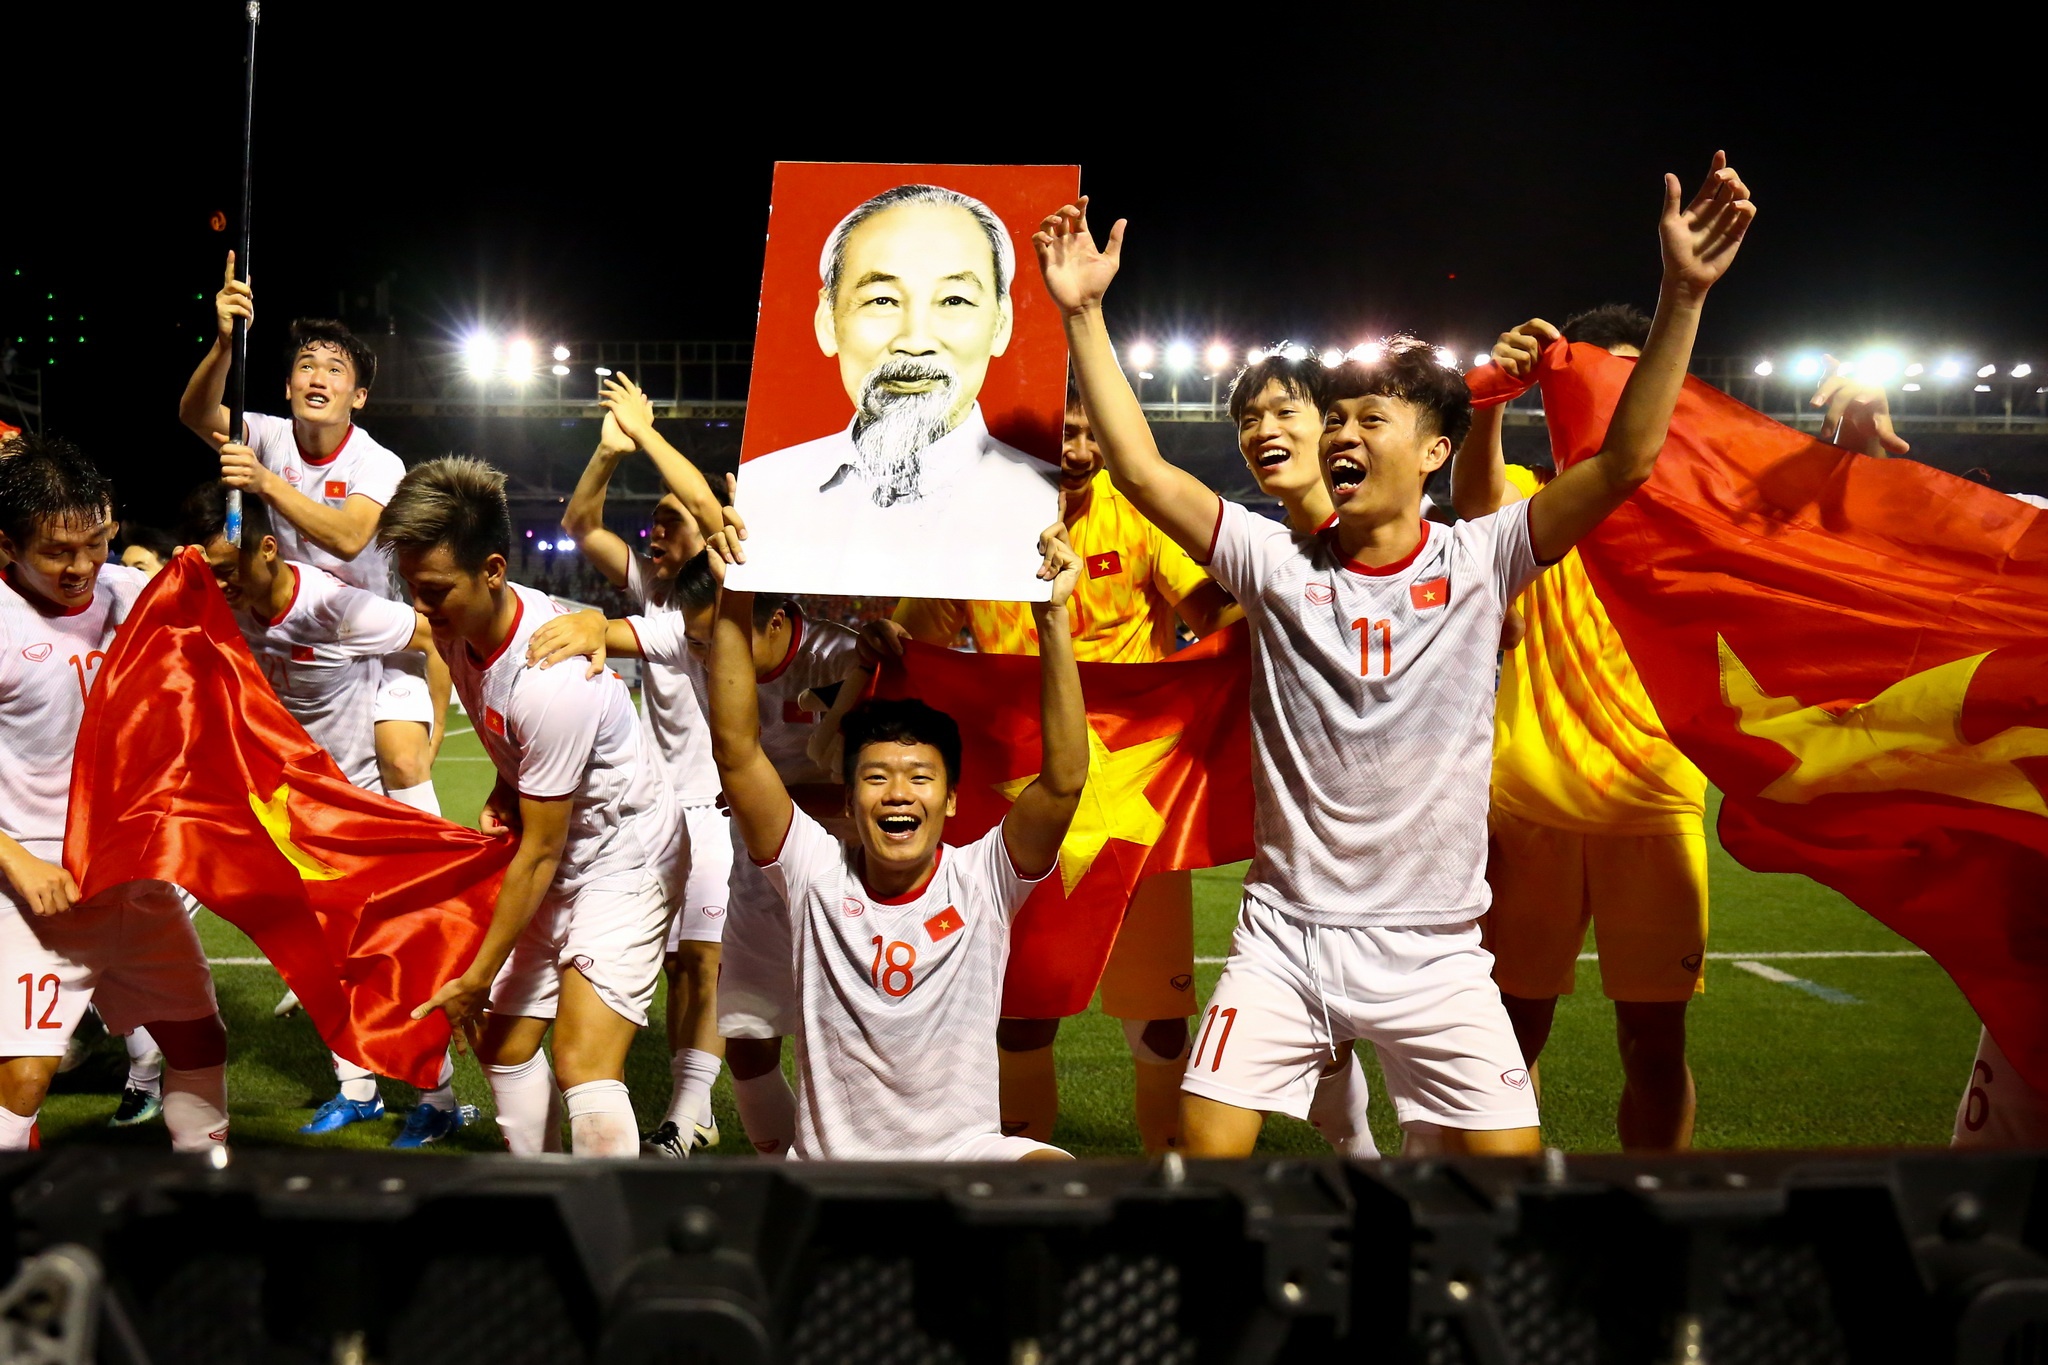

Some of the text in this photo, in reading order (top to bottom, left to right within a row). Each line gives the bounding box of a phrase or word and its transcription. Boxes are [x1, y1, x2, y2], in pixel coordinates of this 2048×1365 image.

[1351, 617, 1391, 677] 11
[872, 935, 917, 997] 18
[18, 973, 62, 1030] 12
[1194, 1004, 1238, 1073] 11
[1965, 1060, 1993, 1132] 6
